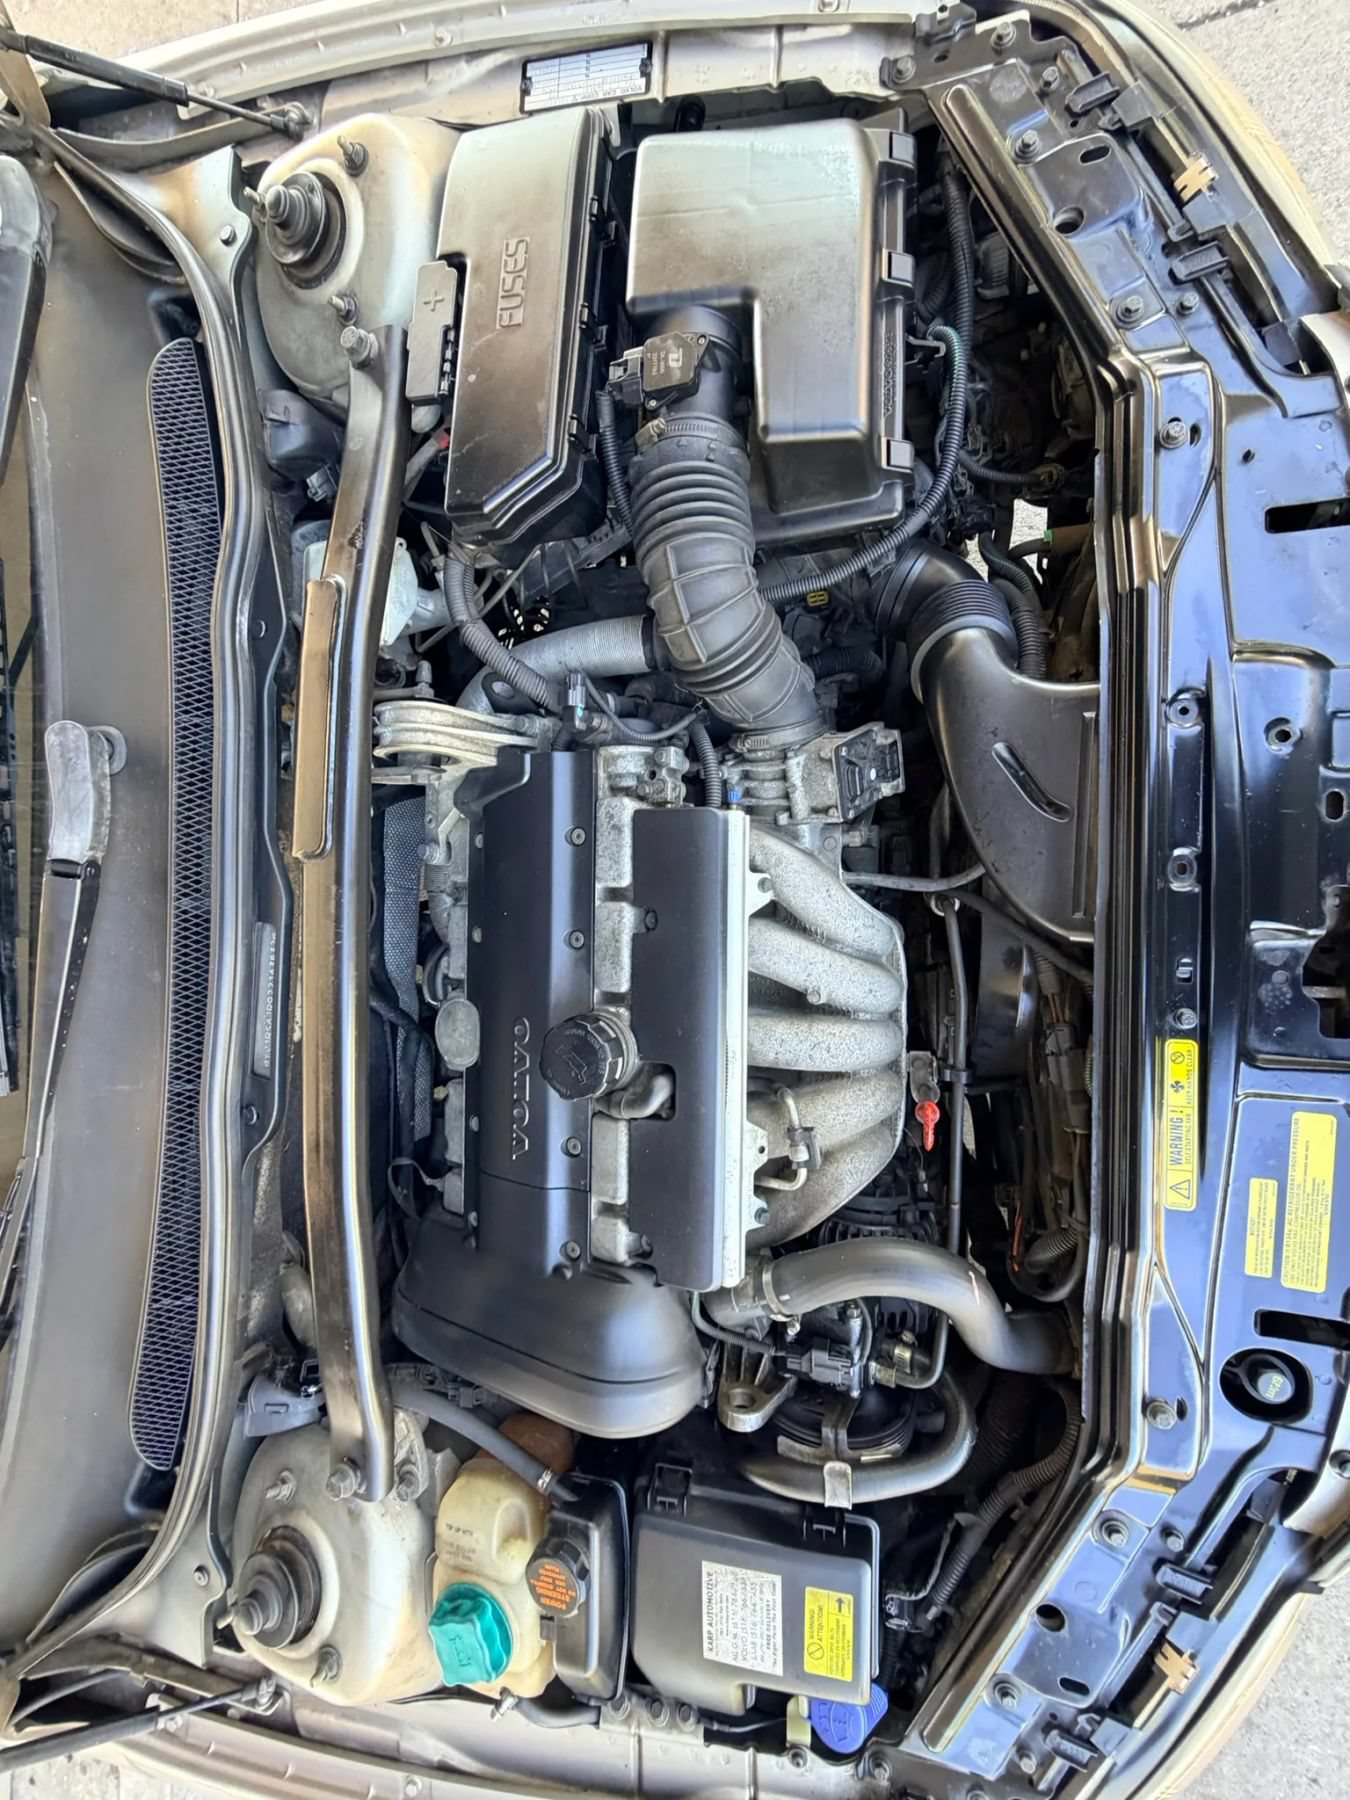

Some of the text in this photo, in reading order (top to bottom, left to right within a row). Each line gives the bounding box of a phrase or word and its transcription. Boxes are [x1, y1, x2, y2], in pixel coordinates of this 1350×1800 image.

[498, 239, 529, 329] FUSES
[511, 1016, 530, 1161] VOLVO
[1169, 1116, 1183, 1166] WARNING
[1282, 1254, 1290, 1281] CAUTION
[1286, 1174, 1295, 1216] REFRIGERANT
[1291, 1117, 1299, 1149] PRESSURE
[535, 1586, 570, 1602] STEERING
[540, 1596, 567, 1610] POWER
